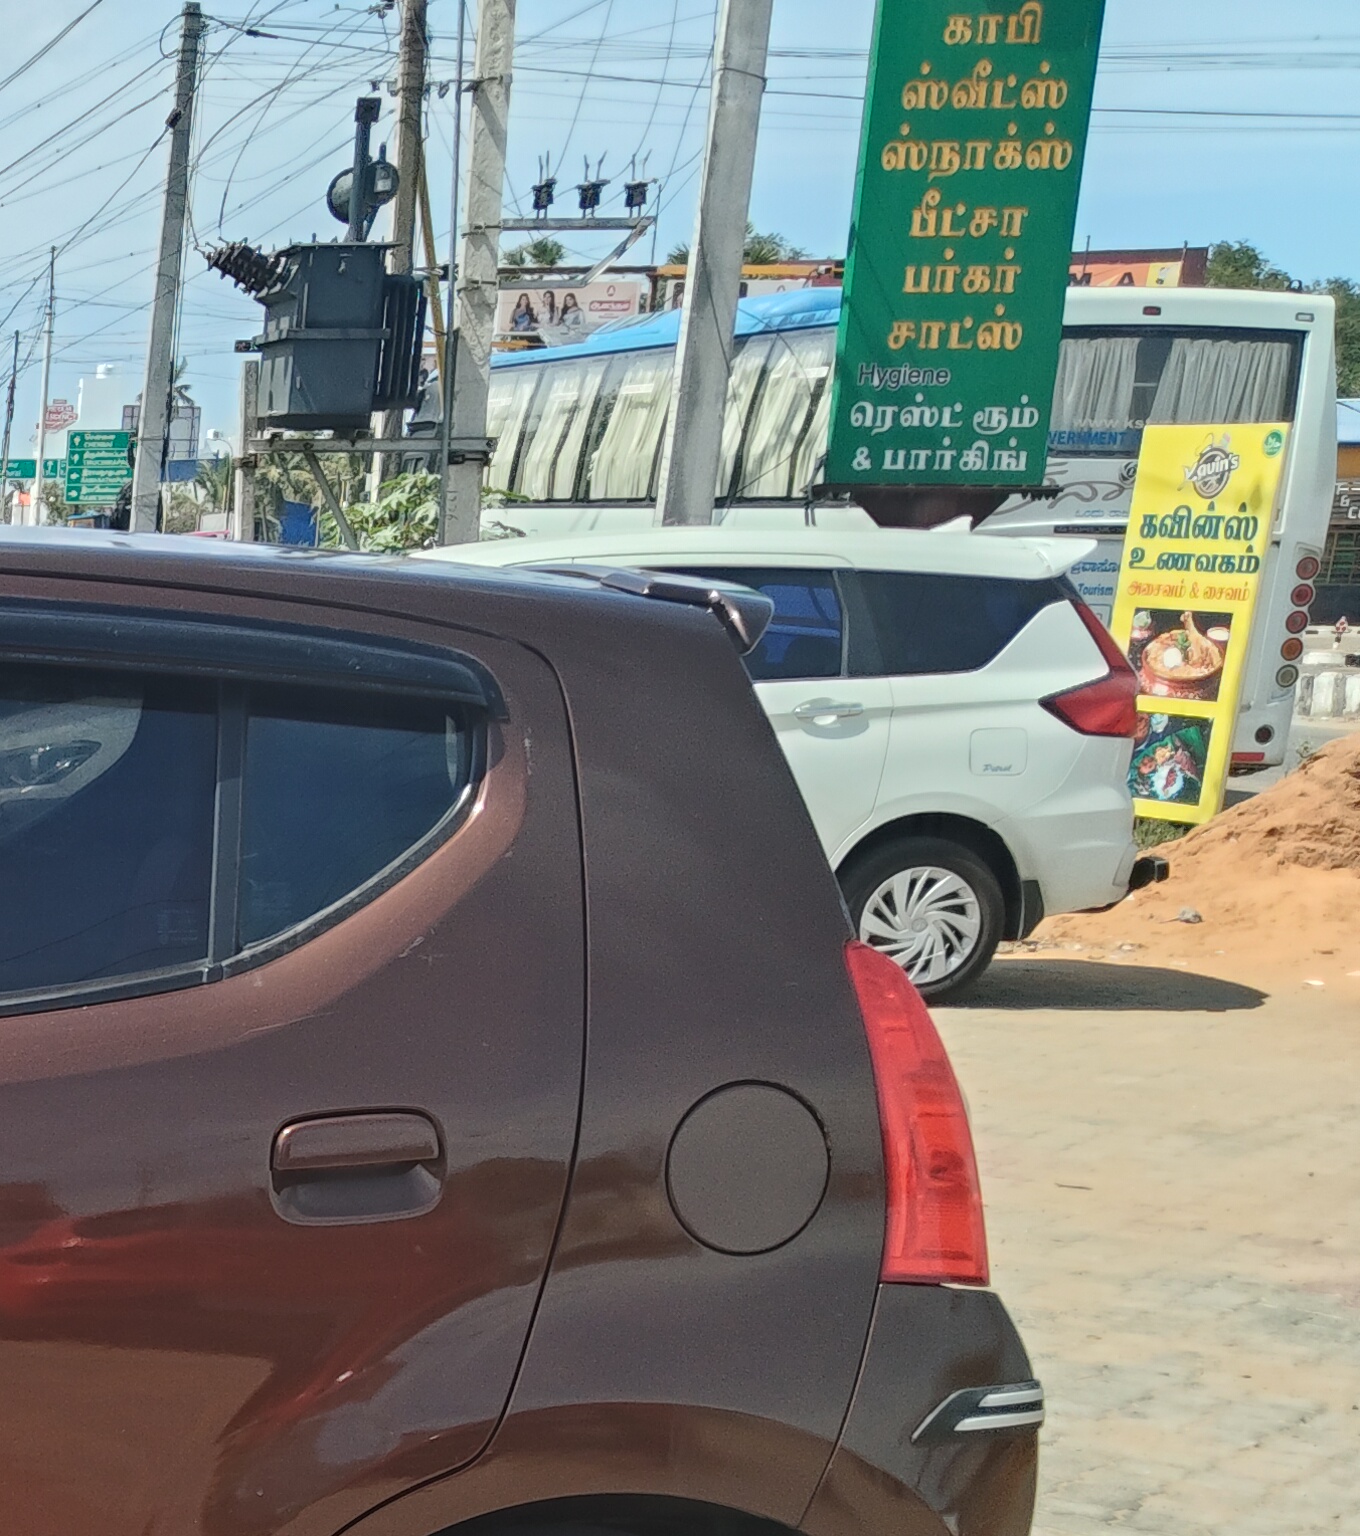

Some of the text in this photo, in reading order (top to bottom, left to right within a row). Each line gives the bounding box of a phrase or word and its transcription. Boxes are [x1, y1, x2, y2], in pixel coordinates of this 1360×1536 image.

[943, 1, 1043, 45] காபி
[902, 58, 1068, 110] ஸ்வீட்ஸ்
[881, 120, 1073, 181] ஸ்நாக்ஸ்
[908, 187, 1029, 238] பீட்சா
[901, 246, 1022, 294] பர்கர்
[886, 302, 1023, 350] சாட்ஸ்
[857, 363, 951, 391] Hygiene
[850, 392, 1040, 436] ரெஸ்ட் ரூம்
[852, 436, 1029, 472] & பார்கிங்
[1139, 500, 1259, 541] கவின்ஸ்
[1128, 544, 1260, 574] உணவகம்
[1078, 583, 1114, 596] Tourism
[1127, 578, 1251, 601] அசைவம் & சைவம்
